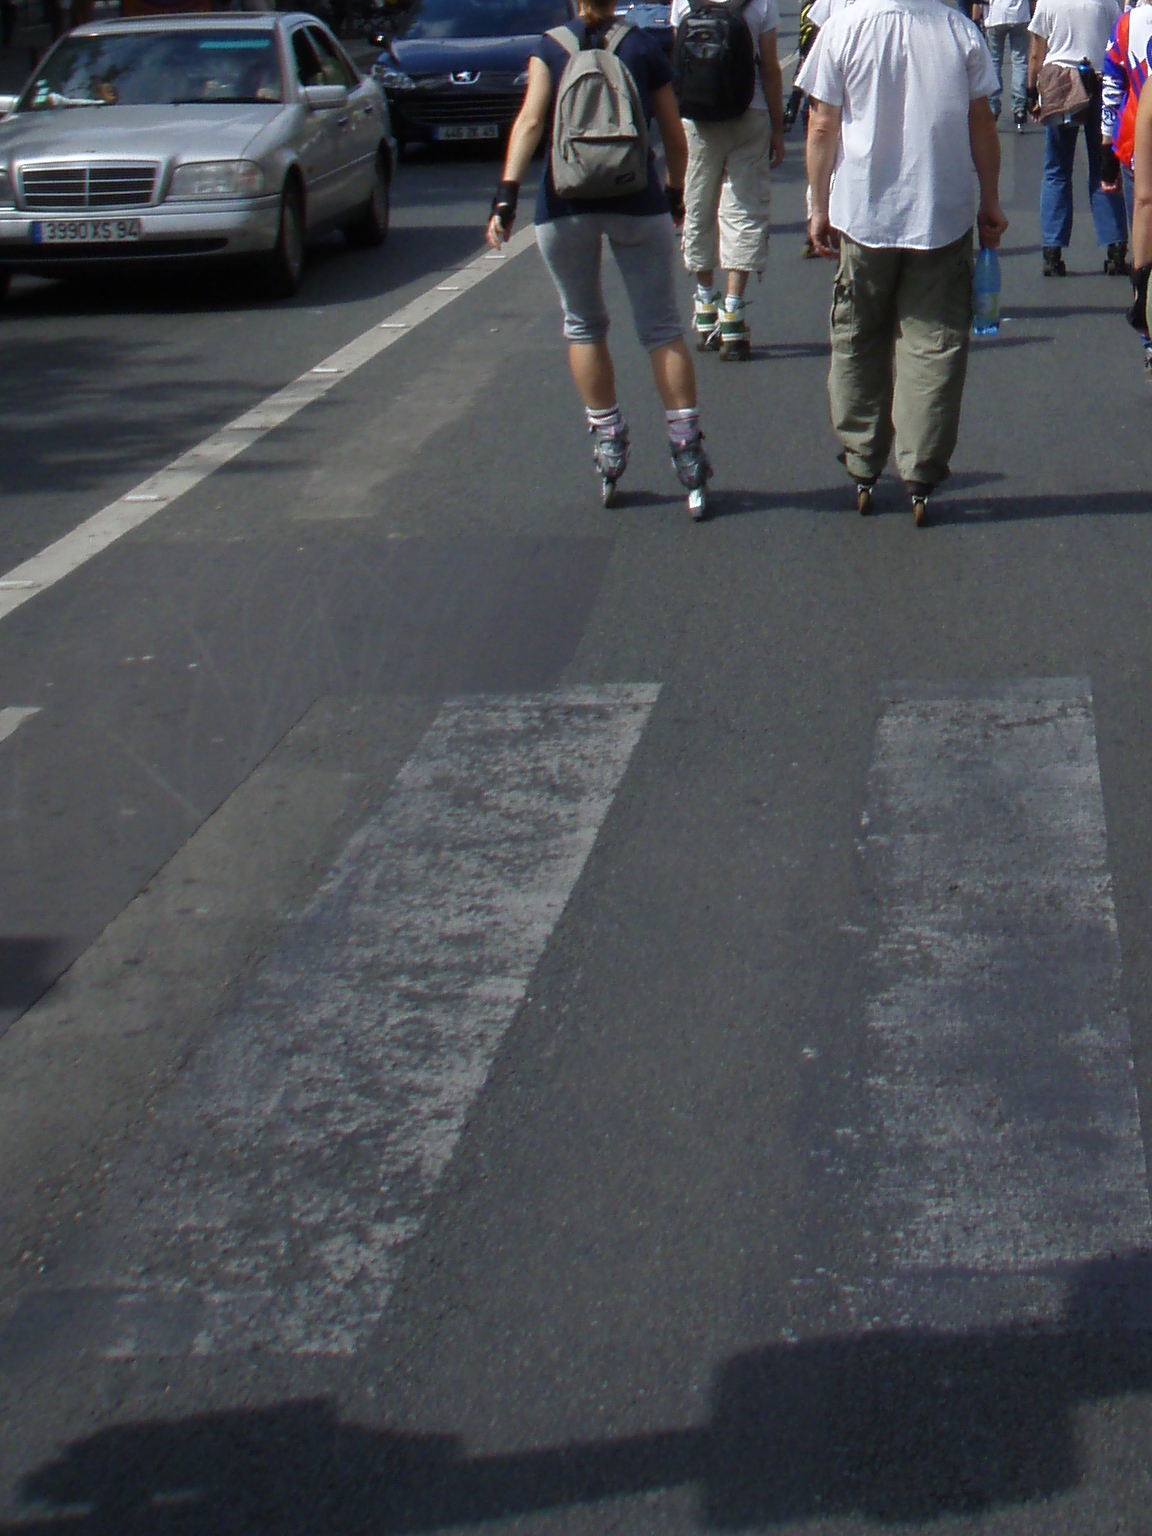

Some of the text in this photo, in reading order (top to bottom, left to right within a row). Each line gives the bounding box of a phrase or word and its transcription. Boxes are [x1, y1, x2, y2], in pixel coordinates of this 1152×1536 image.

[47, 221, 138, 239] 3990 XS 94
